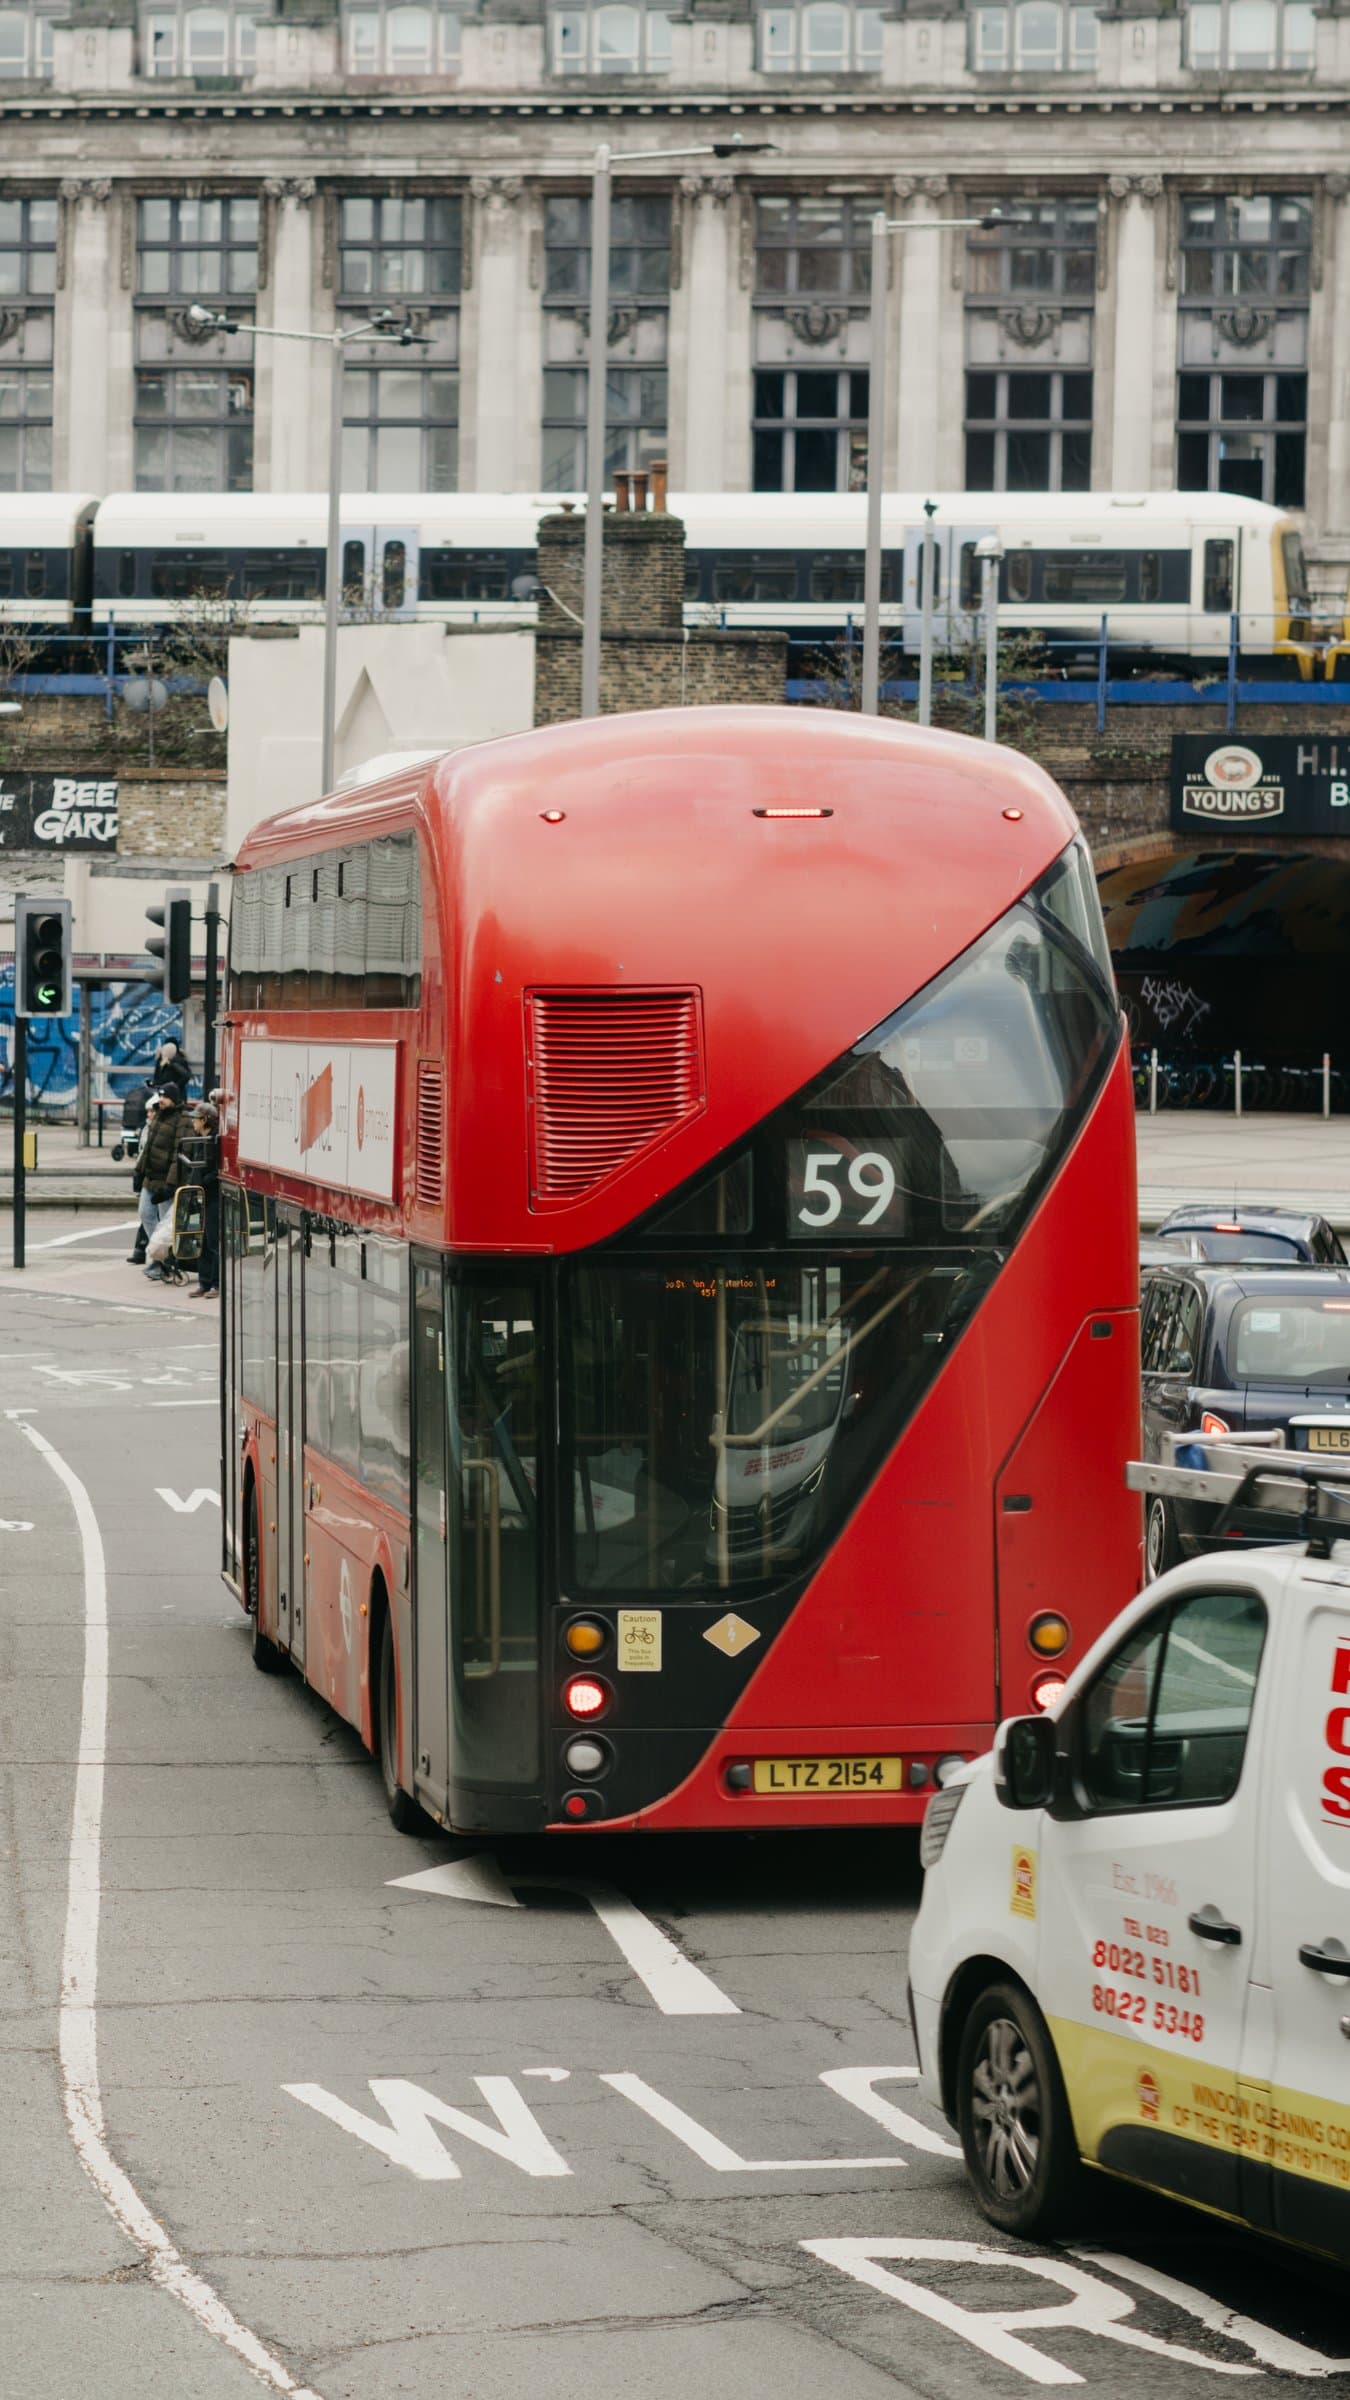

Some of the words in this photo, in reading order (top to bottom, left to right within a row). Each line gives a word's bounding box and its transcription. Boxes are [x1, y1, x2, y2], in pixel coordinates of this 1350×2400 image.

[1297, 745, 1350, 776] H.I.
[52, 778, 118, 810] BEE
[1191, 790, 1275, 812] YOUNG'S
[1330, 782, 1350, 806] B
[798, 1152, 895, 1227] 59
[769, 1763, 819, 1787] LTZ
[828, 1762, 884, 1786] 2154
[1092, 1940, 1146, 1979] 8022
[1152, 1957, 1200, 1997] 5181
[1092, 1984, 1146, 2024] 8022
[1153, 2002, 1204, 2043] 5348
[1174, 2105, 1190, 2127] OF
[1193, 2111, 1219, 2140] THE
[1223, 2121, 1258, 2152] YEAR
[1192, 2083, 1249, 2120] WINDOW
[1253, 2102, 1324, 2144] CLEANING
